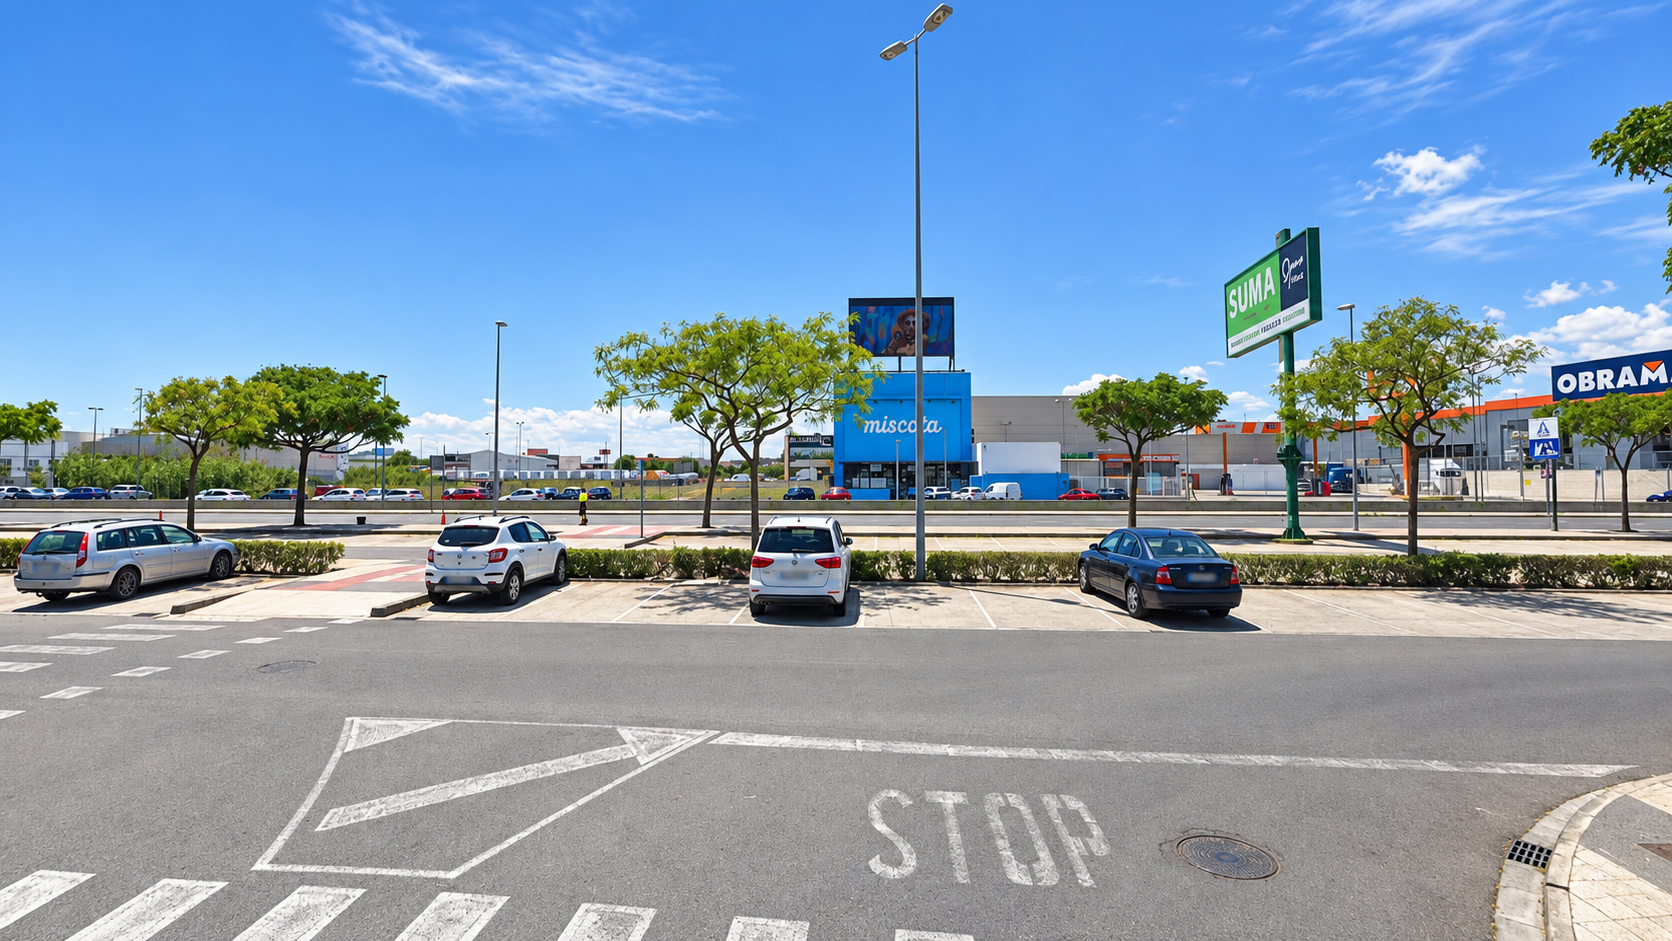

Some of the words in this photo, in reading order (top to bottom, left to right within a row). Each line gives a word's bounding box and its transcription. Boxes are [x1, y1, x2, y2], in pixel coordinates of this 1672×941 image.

[1229, 266, 1276, 319] SUMA
[1557, 361, 1672, 394] OBRAM
[863, 415, 943, 433] miscota
[868, 789, 1111, 888] STOP
